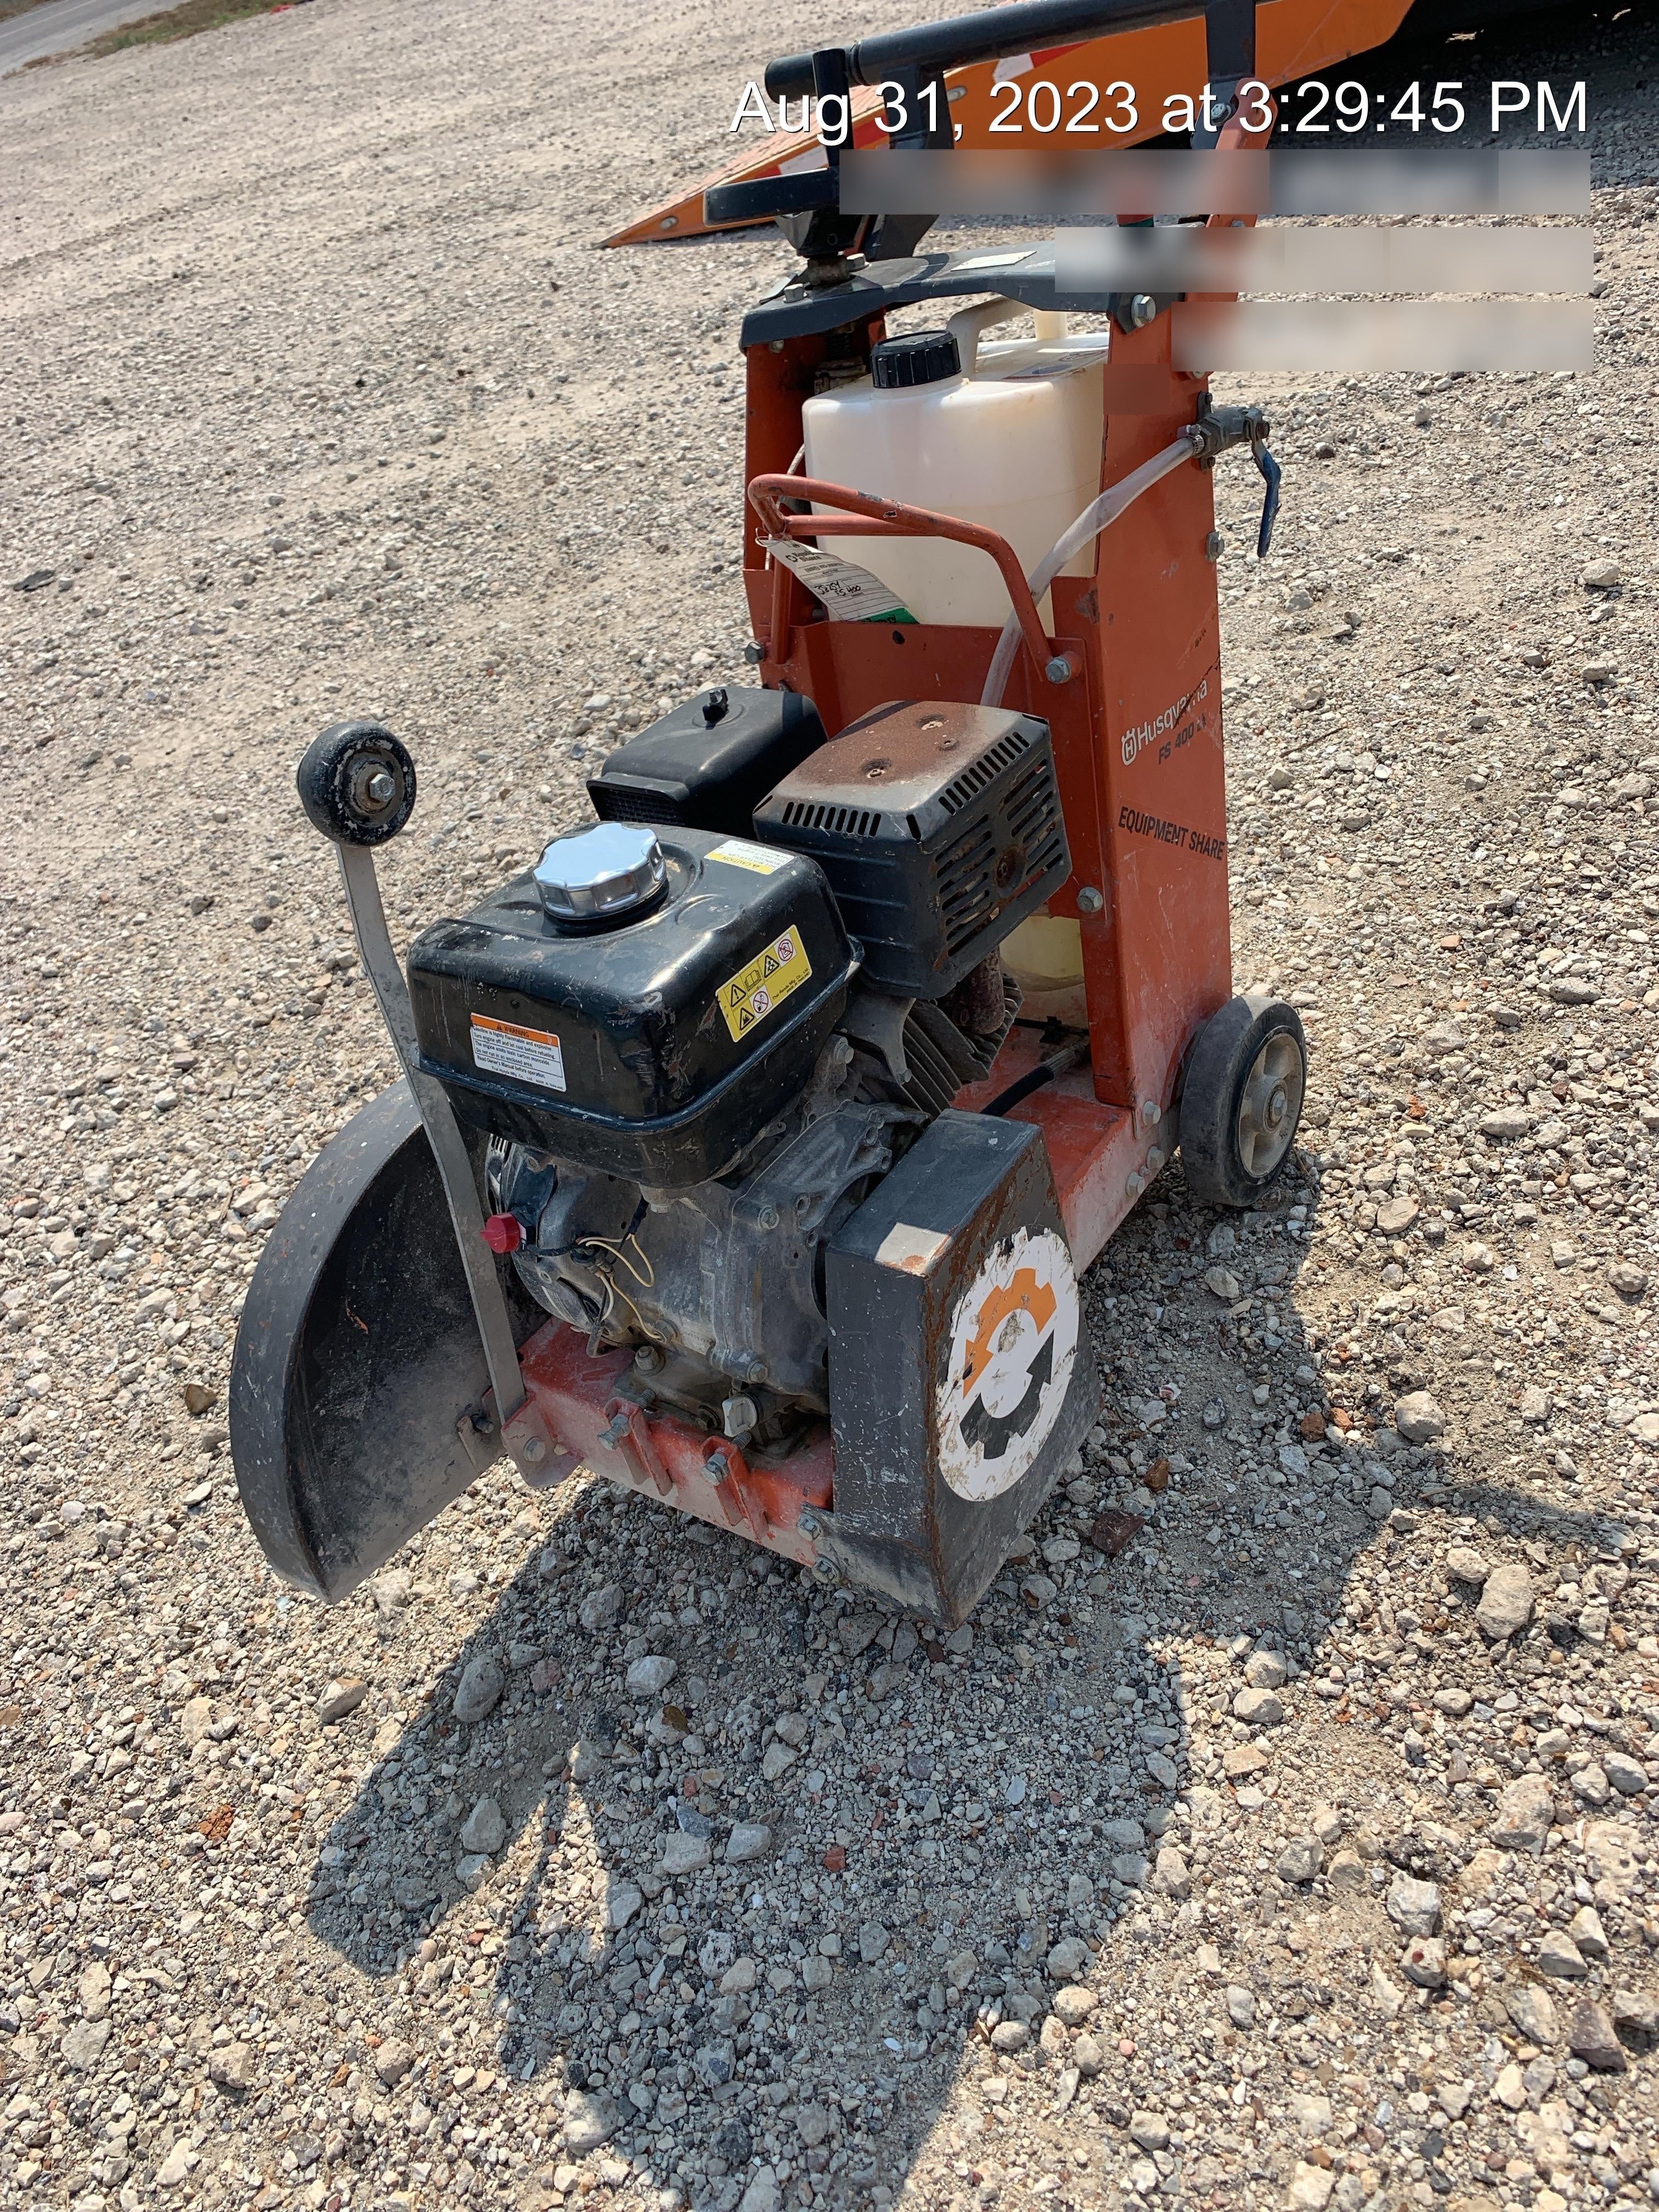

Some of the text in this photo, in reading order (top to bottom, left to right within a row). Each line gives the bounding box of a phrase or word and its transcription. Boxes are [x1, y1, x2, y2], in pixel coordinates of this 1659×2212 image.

[1137, 679, 1207, 751] Husqvana
[1158, 741, 1171, 764] FS
[1175, 721, 1194, 748] 400
[1118, 806, 1225, 861] EQUIPMENT SHARE
[722, 856, 751, 866] CAUTION
[504, 1025, 529, 1037] WARNING
[505, 1035, 524, 1043] flammable
